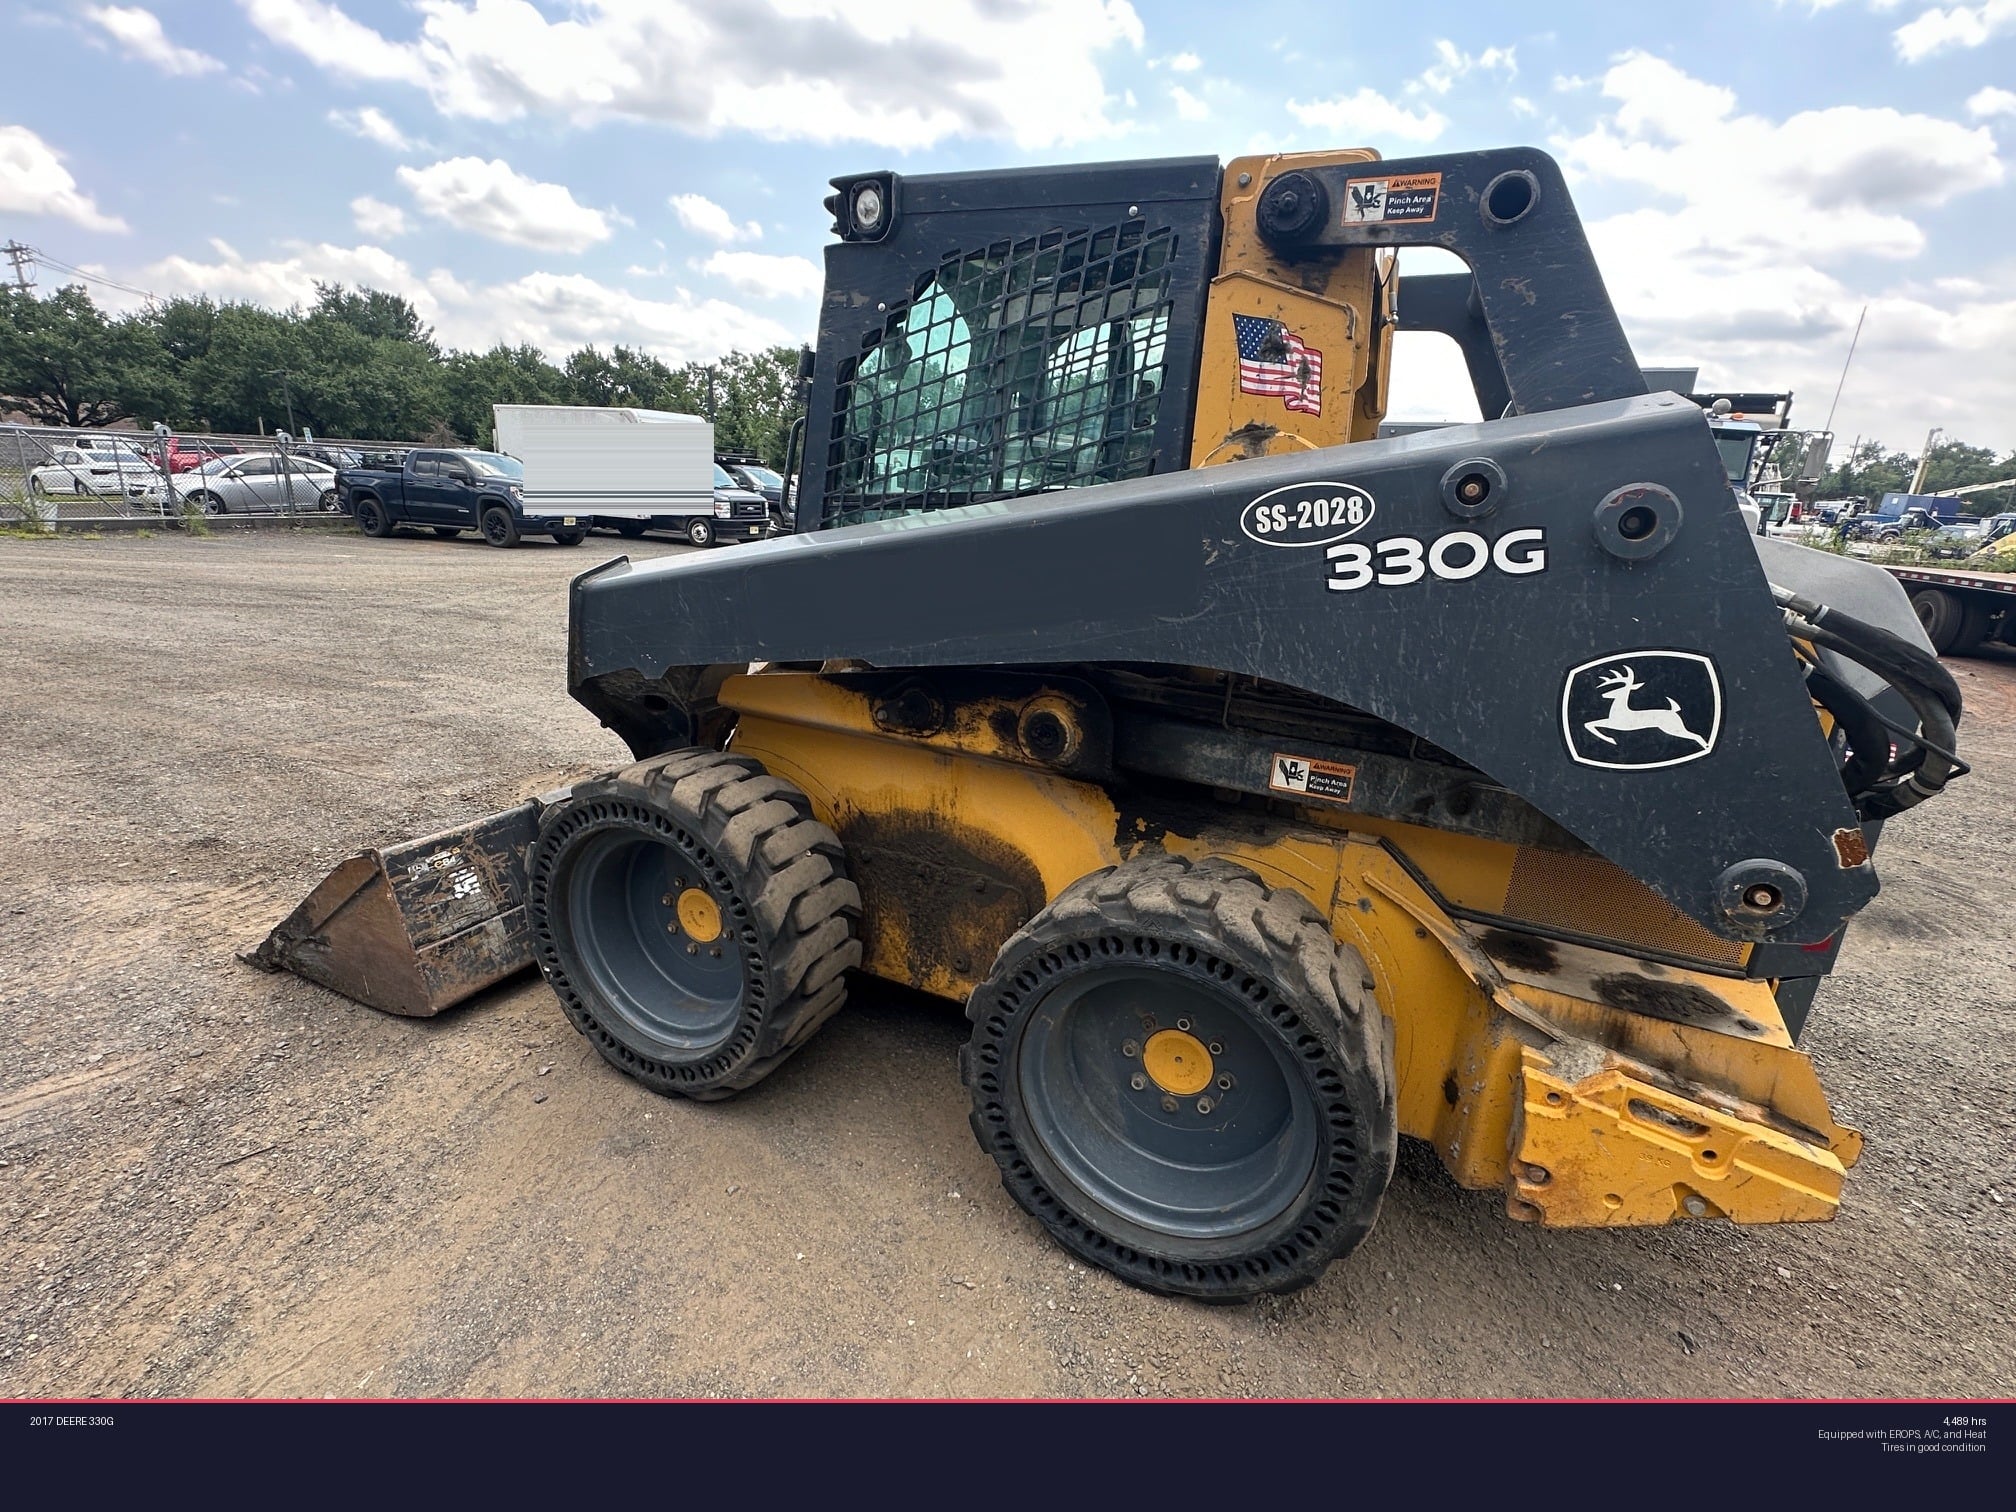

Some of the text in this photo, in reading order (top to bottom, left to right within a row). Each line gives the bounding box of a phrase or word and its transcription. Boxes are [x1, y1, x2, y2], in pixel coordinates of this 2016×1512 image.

[1400, 177, 1436, 187] WARNING
[1389, 195, 1432, 205] Pinch Area
[1387, 206, 1424, 216] Keep Away
[1255, 495, 1364, 534] SS-2028
[1326, 528, 1546, 591] 330G
[1319, 764, 1351, 775] WARNING
[1310, 775, 1347, 788] Pinch Area
[1309, 783, 1341, 795] Keep Away
